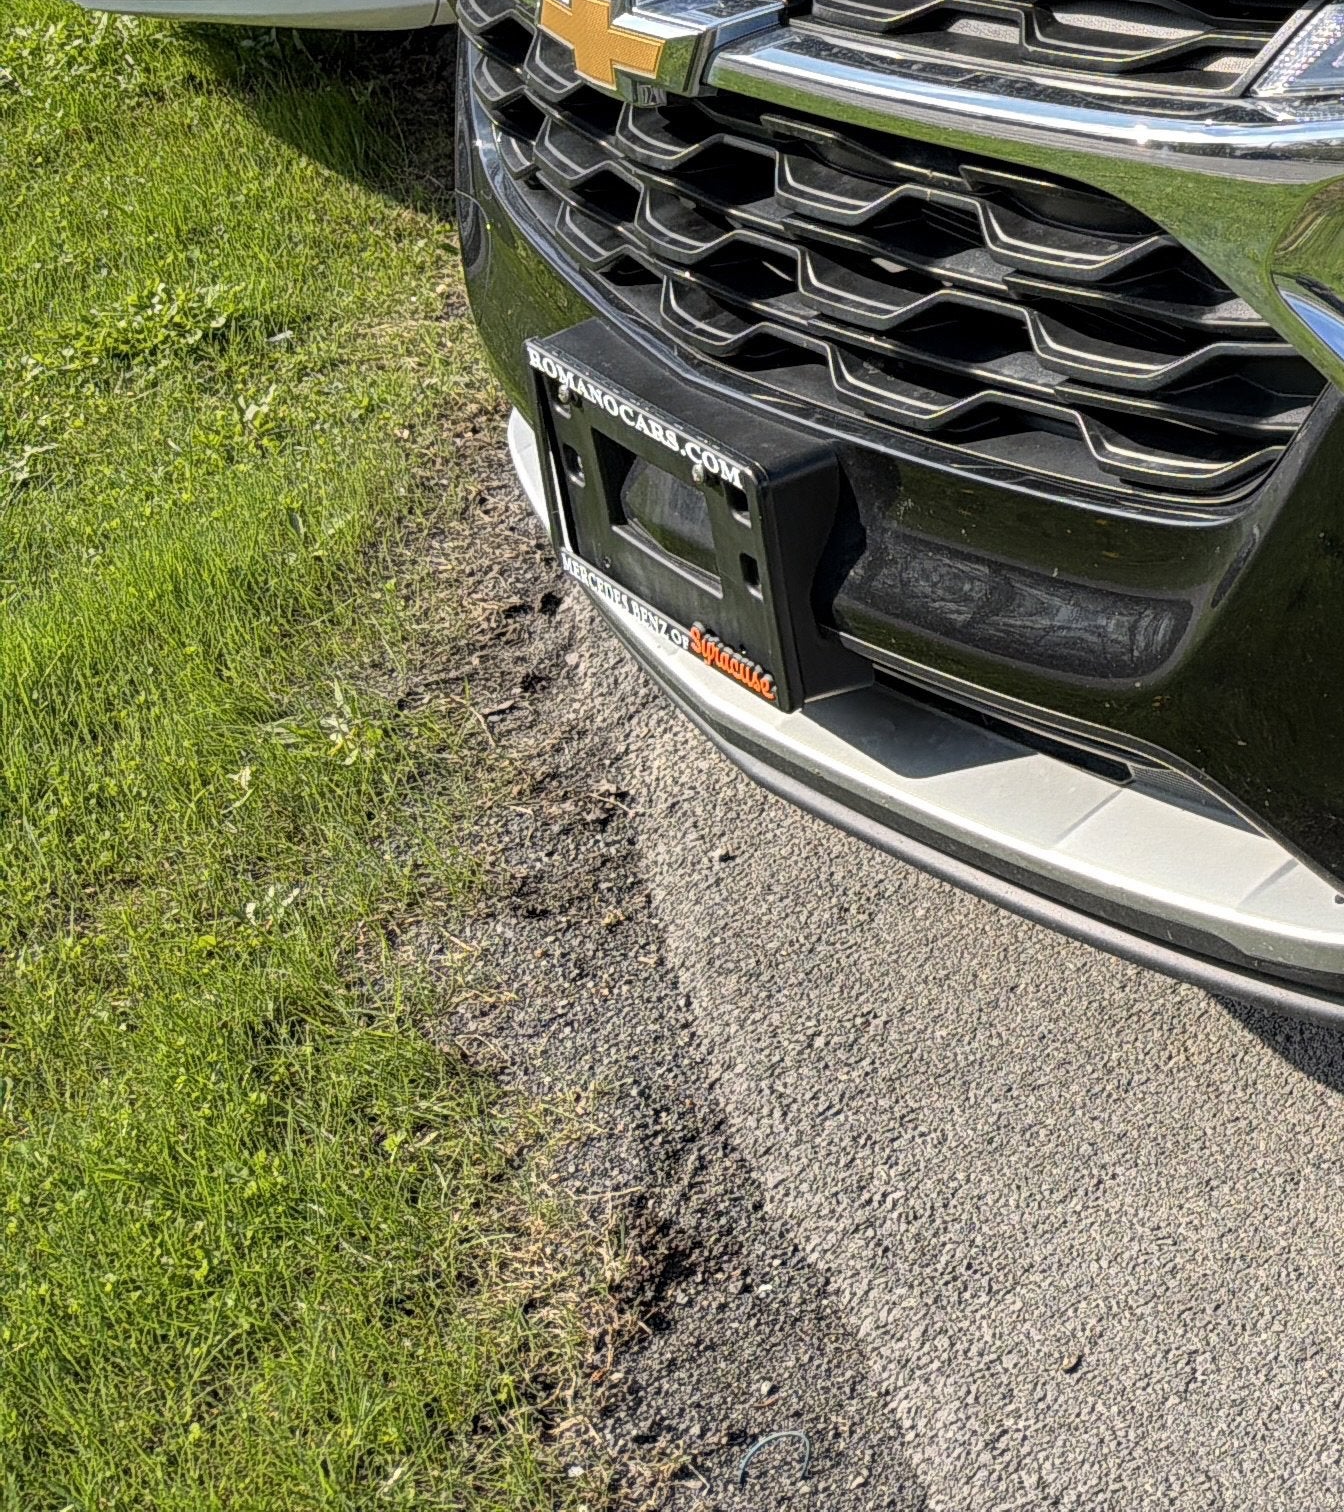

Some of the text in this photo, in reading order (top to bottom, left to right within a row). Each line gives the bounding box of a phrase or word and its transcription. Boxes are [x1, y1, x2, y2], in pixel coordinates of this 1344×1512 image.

[526, 346, 744, 490] ROMANOCARS.COM
[561, 552, 776, 701] MERCEDES BENZ OF Syracuse
